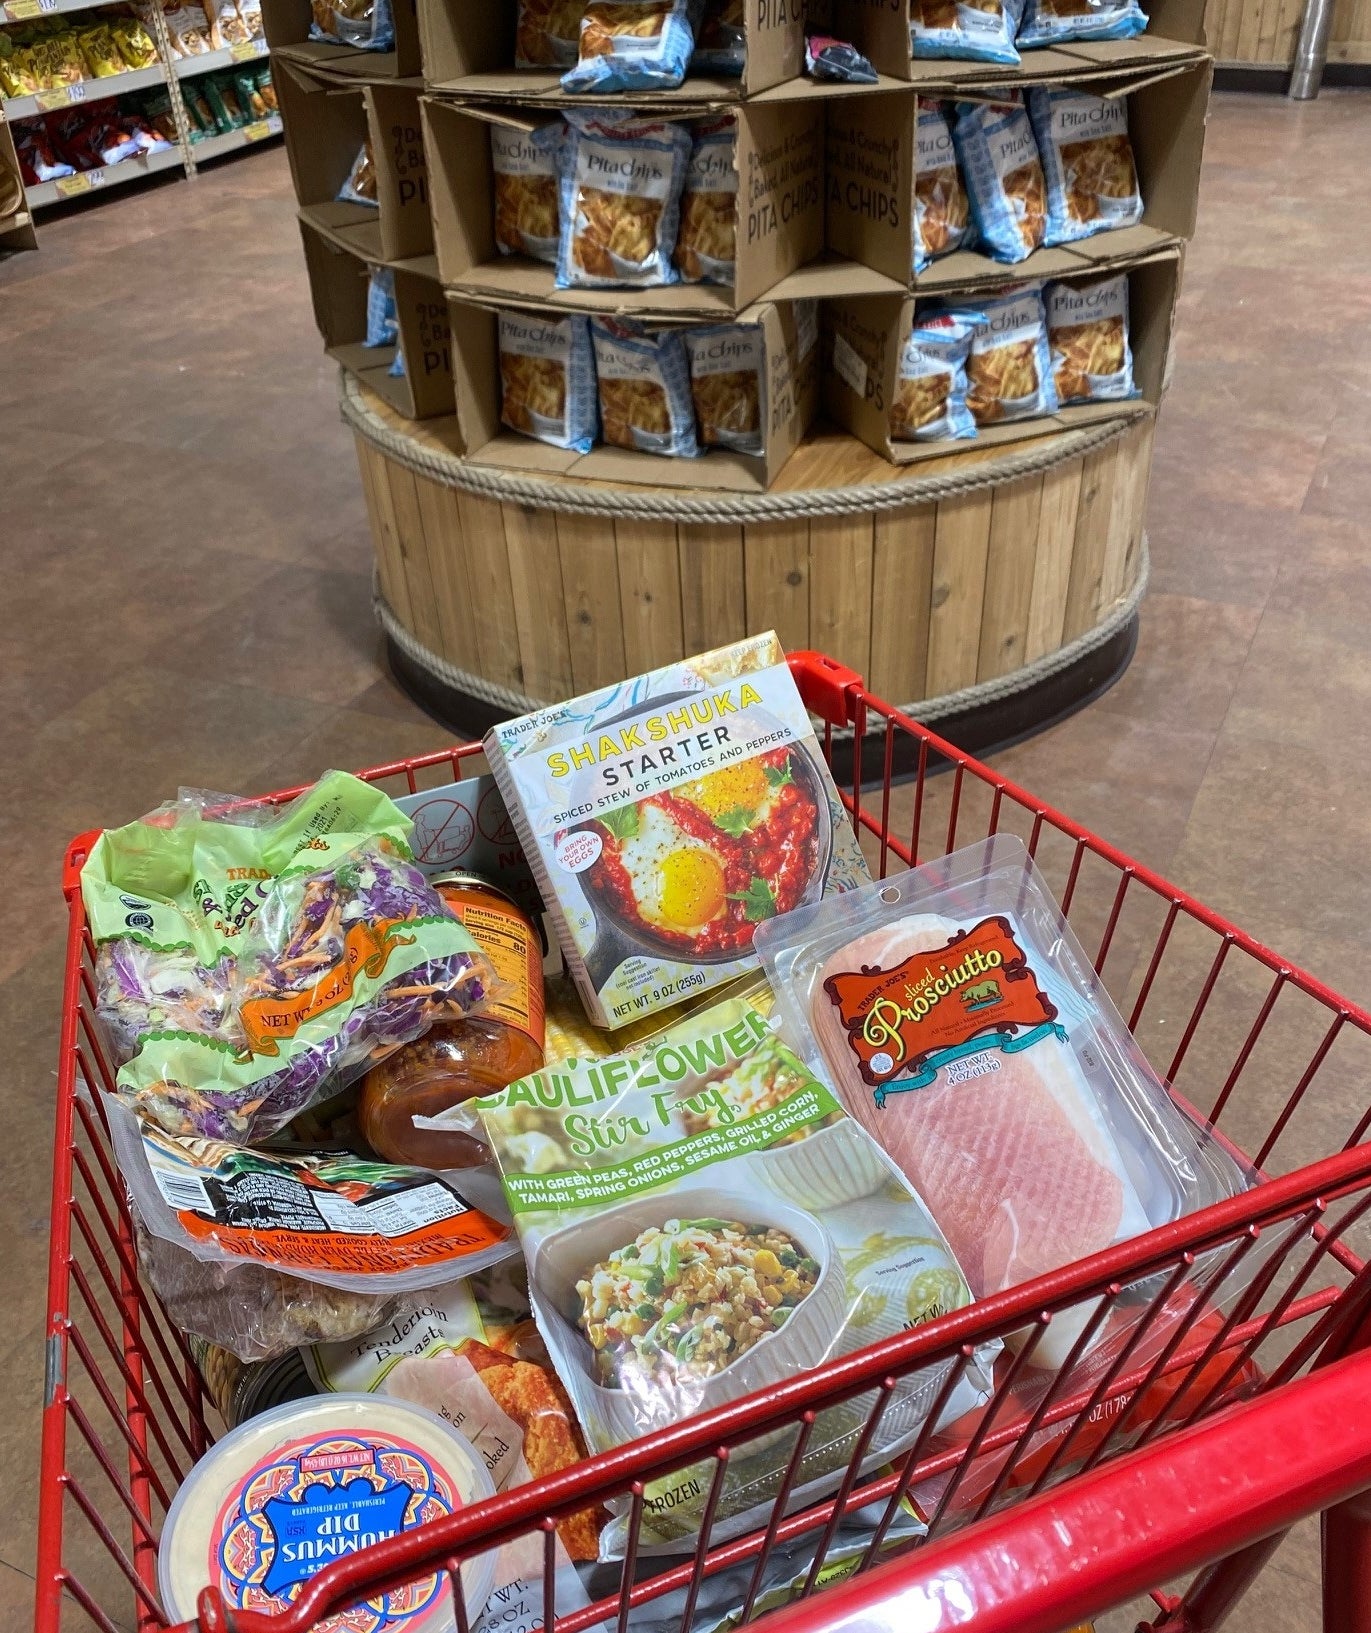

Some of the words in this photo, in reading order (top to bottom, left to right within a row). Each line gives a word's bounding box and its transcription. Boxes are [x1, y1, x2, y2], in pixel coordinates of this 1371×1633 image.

[1060, 111, 1088, 129] Pita
[916, 137, 935, 152] ita
[587, 154, 620, 175] Pita
[620, 156, 663, 181] Chips
[846, 181, 900, 228] CHIPS
[748, 203, 778, 245] PITA
[1054, 295, 1083, 312] Pita
[989, 306, 1031, 332] Chips
[502, 717, 539, 739] TRADER
[546, 683, 763, 778] SHAKSHUKA
[602, 725, 731, 787] STARTER
[553, 802, 593, 824] SPICED
[597, 788, 632, 809] STEW
[635, 780, 652, 793] OF
[655, 758, 715, 787] TOMATOES
[719, 746, 743, 761] AND
[746, 727, 792, 751] PEPPERS
[315, 816, 329, 832] 2021
[558, 848, 579, 864] YOUR
[579, 836, 599, 853] OWN
[564, 834, 588, 853] BRING
[568, 848, 594, 868] EGGS
[226, 867, 272, 880] TRAD
[466, 907, 504, 921] Nutrition
[505, 917, 527, 932] Facts
[471, 931, 502, 944] alories
[513, 942, 527, 954] 80
[325, 985, 344, 1000] OZ
[612, 1002, 632, 1018] NET
[634, 995, 653, 1009] WT.
[653, 990, 660, 1000] 9
[661, 984, 676, 997] OZ
[676, 971, 706, 993] (255g)
[904, 967, 936, 1001] sliced
[857, 986, 884, 1011] TRADER
[863, 949, 1003, 1062] Prosciutto
[260, 1014, 291, 1028] NET
[946, 1059, 971, 1073] NET
[948, 1075, 955, 1085] 4
[956, 1070, 972, 1082] OZ
[972, 1060, 1002, 1080] (113g)
[564, 1112, 651, 1156] Stir
[650, 1087, 741, 1127] Fry
[508, 1178, 544, 1192] WITH
[546, 1174, 592, 1190] GREEN
[594, 1167, 633, 1186] PEAS,
[633, 1156, 660, 1174] RED
[662, 1132, 725, 1163] PEPPERS,
[725, 1112, 778, 1138] GRILLED
[778, 1090, 819, 1116] CORN,
[519, 1191, 575, 1205] TAMARI,
[575, 1181, 626, 1201] SPRING
[628, 1162, 685, 1188] ONIONS,
[684, 1141, 738, 1166] SESAME
[761, 1130, 772, 1140] &
[772, 1103, 820, 1133] GINGER
[310, 1236, 331, 1246] HEAT
[372, 1325, 445, 1365] Beasts
[647, 1478, 701, 1514] FROZEN
[291, 1504, 333, 1516] REFRIGERATED
[316, 1512, 361, 1536] DIP
[281, 1529, 397, 1563] HUMMUS
[494, 1578, 529, 1604] WT.
[502, 1601, 531, 1623] OZ
